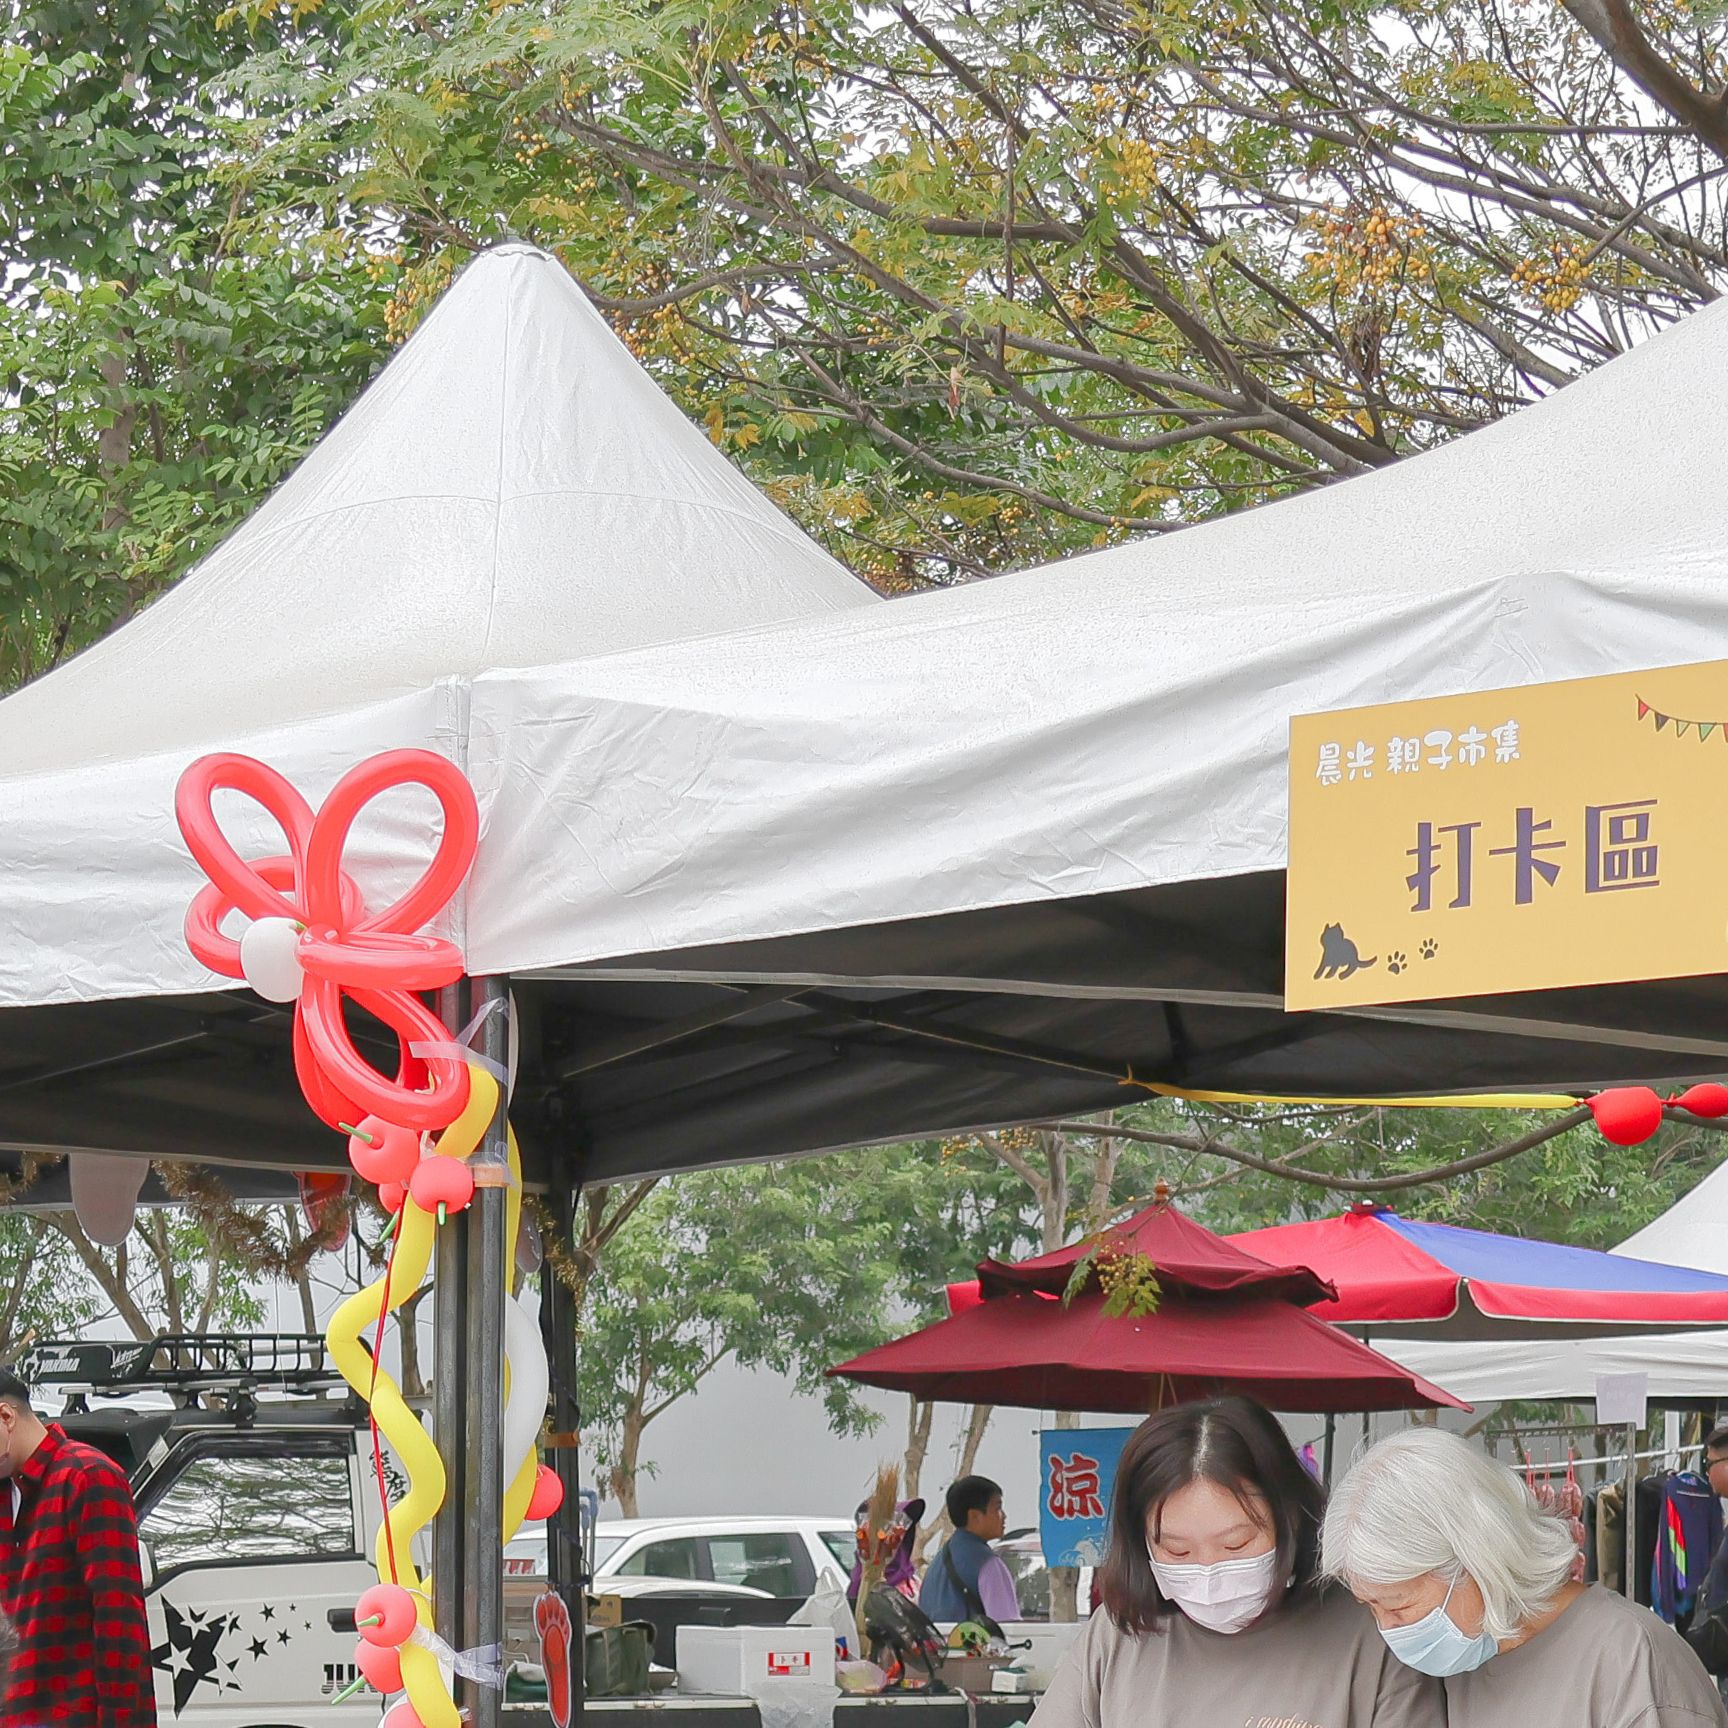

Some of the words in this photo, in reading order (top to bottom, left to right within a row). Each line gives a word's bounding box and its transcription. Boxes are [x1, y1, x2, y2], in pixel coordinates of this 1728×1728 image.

[1316, 741, 1374, 785] 晨光
[1386, 721, 1522, 774] 親子市集
[1406, 799, 1660, 912] 打卡區
[1048, 1452, 1105, 1520] 涼
